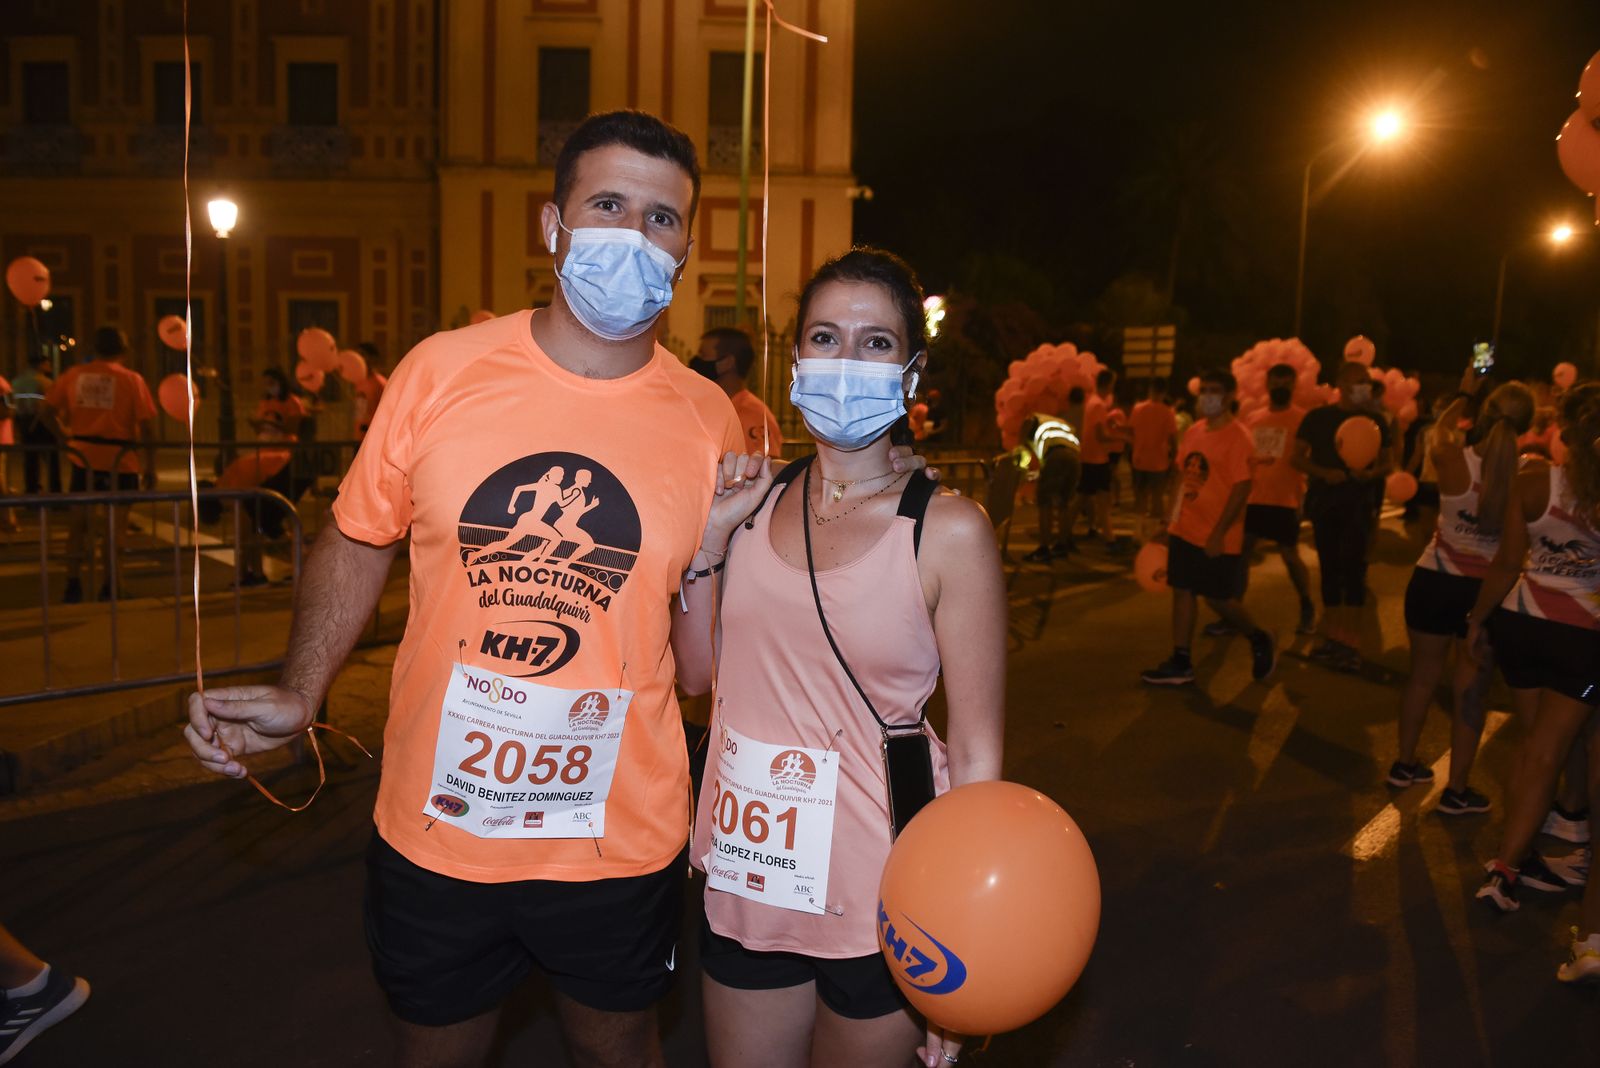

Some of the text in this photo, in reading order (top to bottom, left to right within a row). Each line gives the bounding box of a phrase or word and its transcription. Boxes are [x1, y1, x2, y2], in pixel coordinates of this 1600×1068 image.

[466, 564, 614, 612] LA NOCTURNA
[478, 587, 592, 624] del Guadalquivir
[447, 710, 466, 721] XXXIII
[466, 716, 496, 729] CARRERA
[496, 724, 534, 739] NOCTURNA
[534, 732, 548, 740] DEL
[548, 732, 595, 742] GUADALQUIVIR
[457, 730, 593, 786] 2058
[446, 773, 476, 795] DAVID
[476, 787, 526, 803] BENITEZ
[527, 791, 594, 803] DOMINGUEZ
[743, 786, 754, 795] DEL
[754, 789, 802, 802] GUADALQUIVIR
[780, 779, 812, 791] NOCTURNA
[573, 811, 592, 820] ABC
[719, 840, 751, 861] LOPEZ
[753, 851, 797, 871] FLORES
[794, 884, 814, 894] ABC
